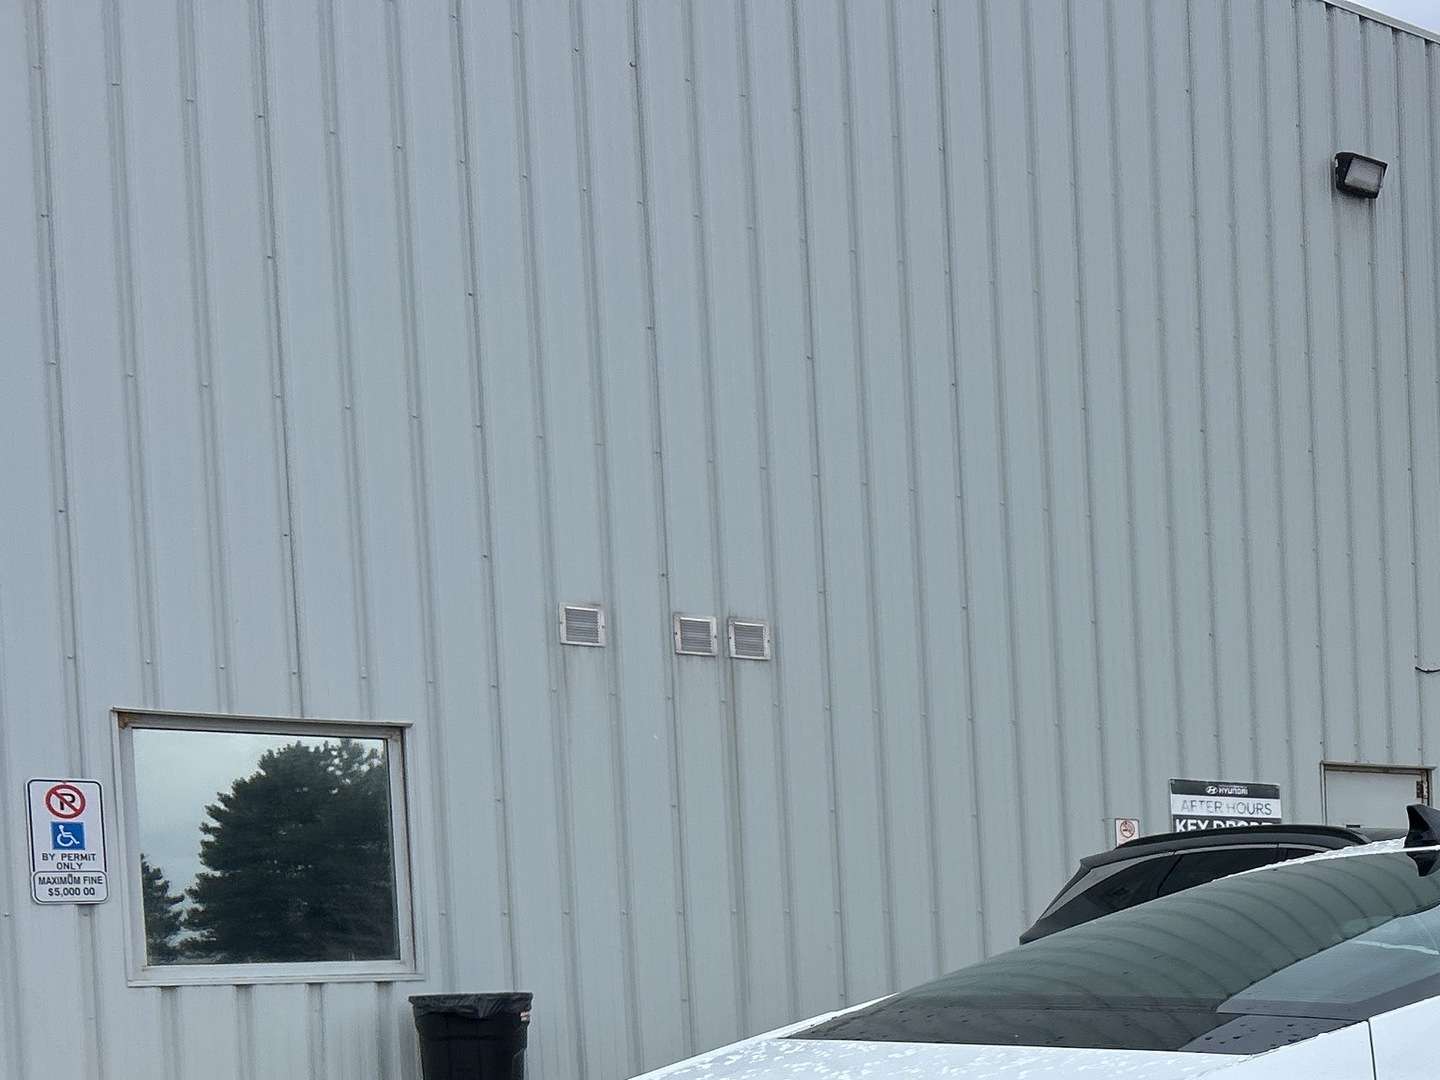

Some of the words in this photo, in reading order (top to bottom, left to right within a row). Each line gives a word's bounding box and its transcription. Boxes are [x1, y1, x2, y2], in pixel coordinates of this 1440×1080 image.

[1181, 799, 1222, 814] AFTER
[1226, 801, 1272, 816] HOURS
[42, 852, 55, 861] BY
[61, 853, 96, 861] PERMIT
[56, 862, 83, 870] ONLY
[38, 875, 81, 885] MAXIMUM
[83, 876, 103, 885] FINE
